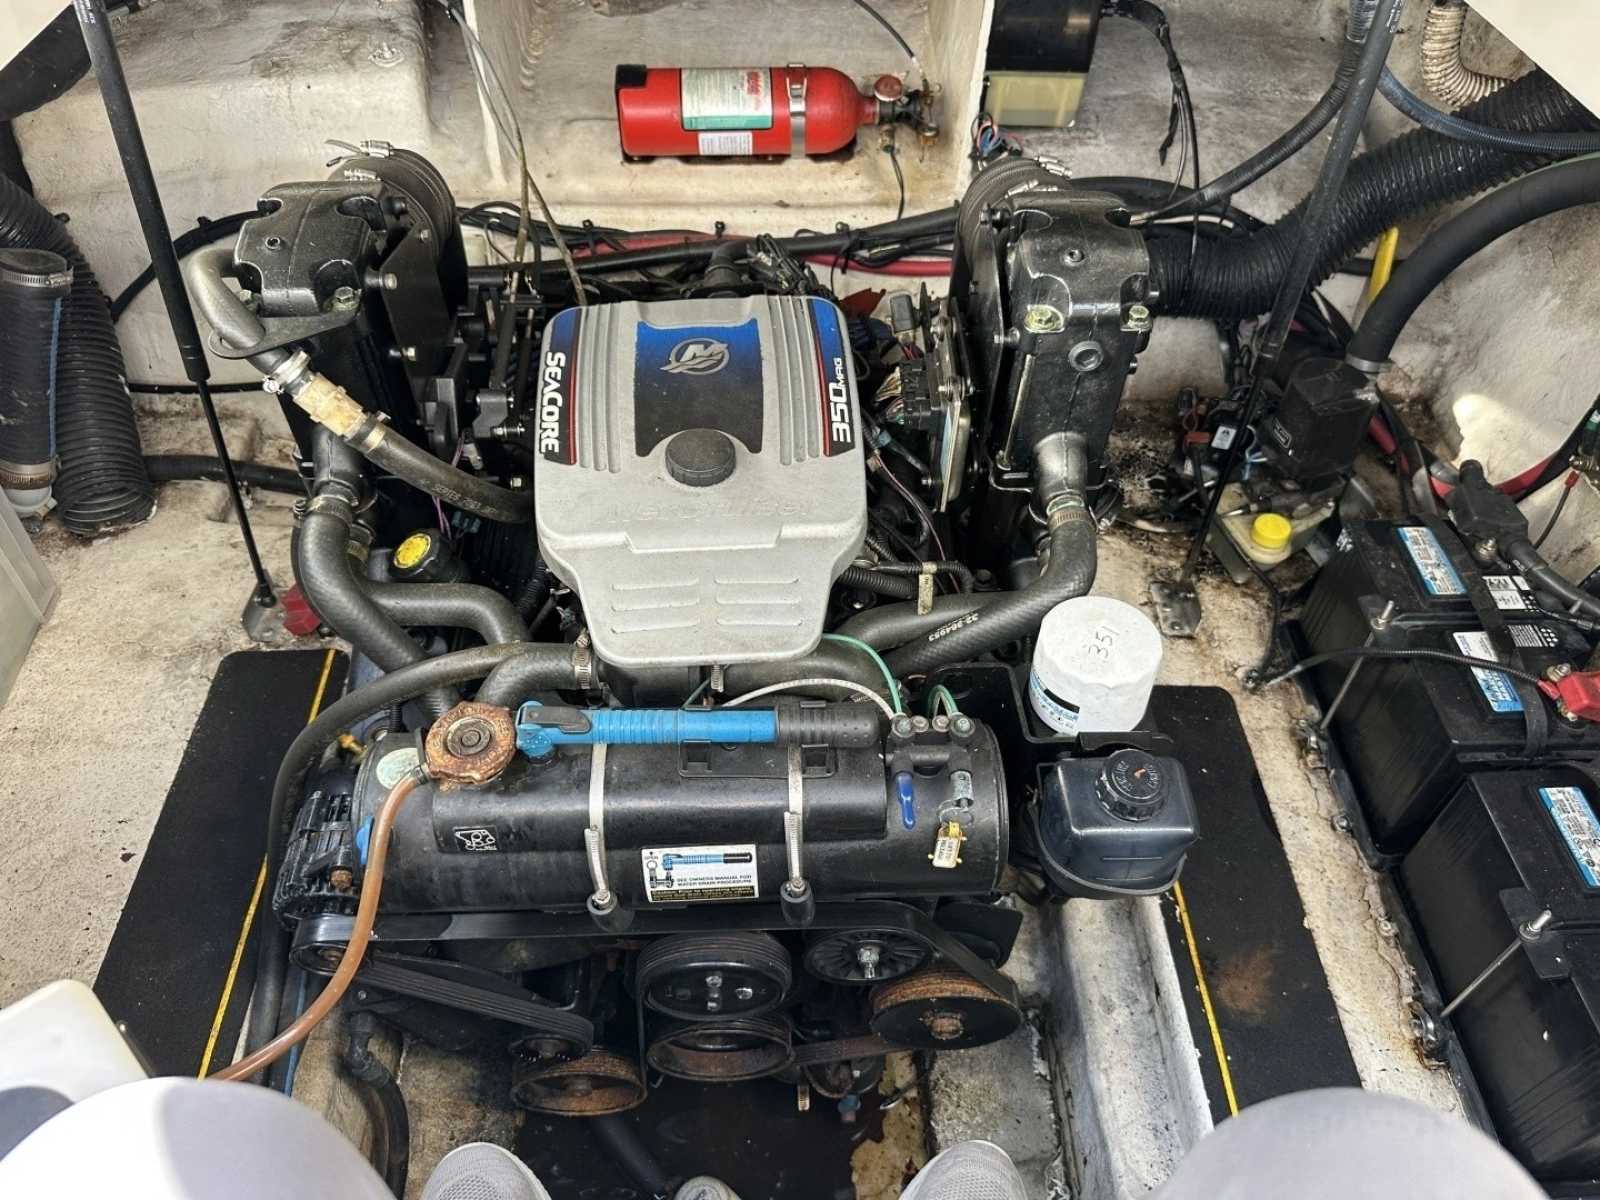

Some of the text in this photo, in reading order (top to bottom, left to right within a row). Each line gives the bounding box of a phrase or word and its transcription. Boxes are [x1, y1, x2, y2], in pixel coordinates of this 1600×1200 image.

[540, 351, 567, 454] SEACORE
[828, 357, 852, 443] 350 MAG
[1088, 626, 1121, 659] 351
